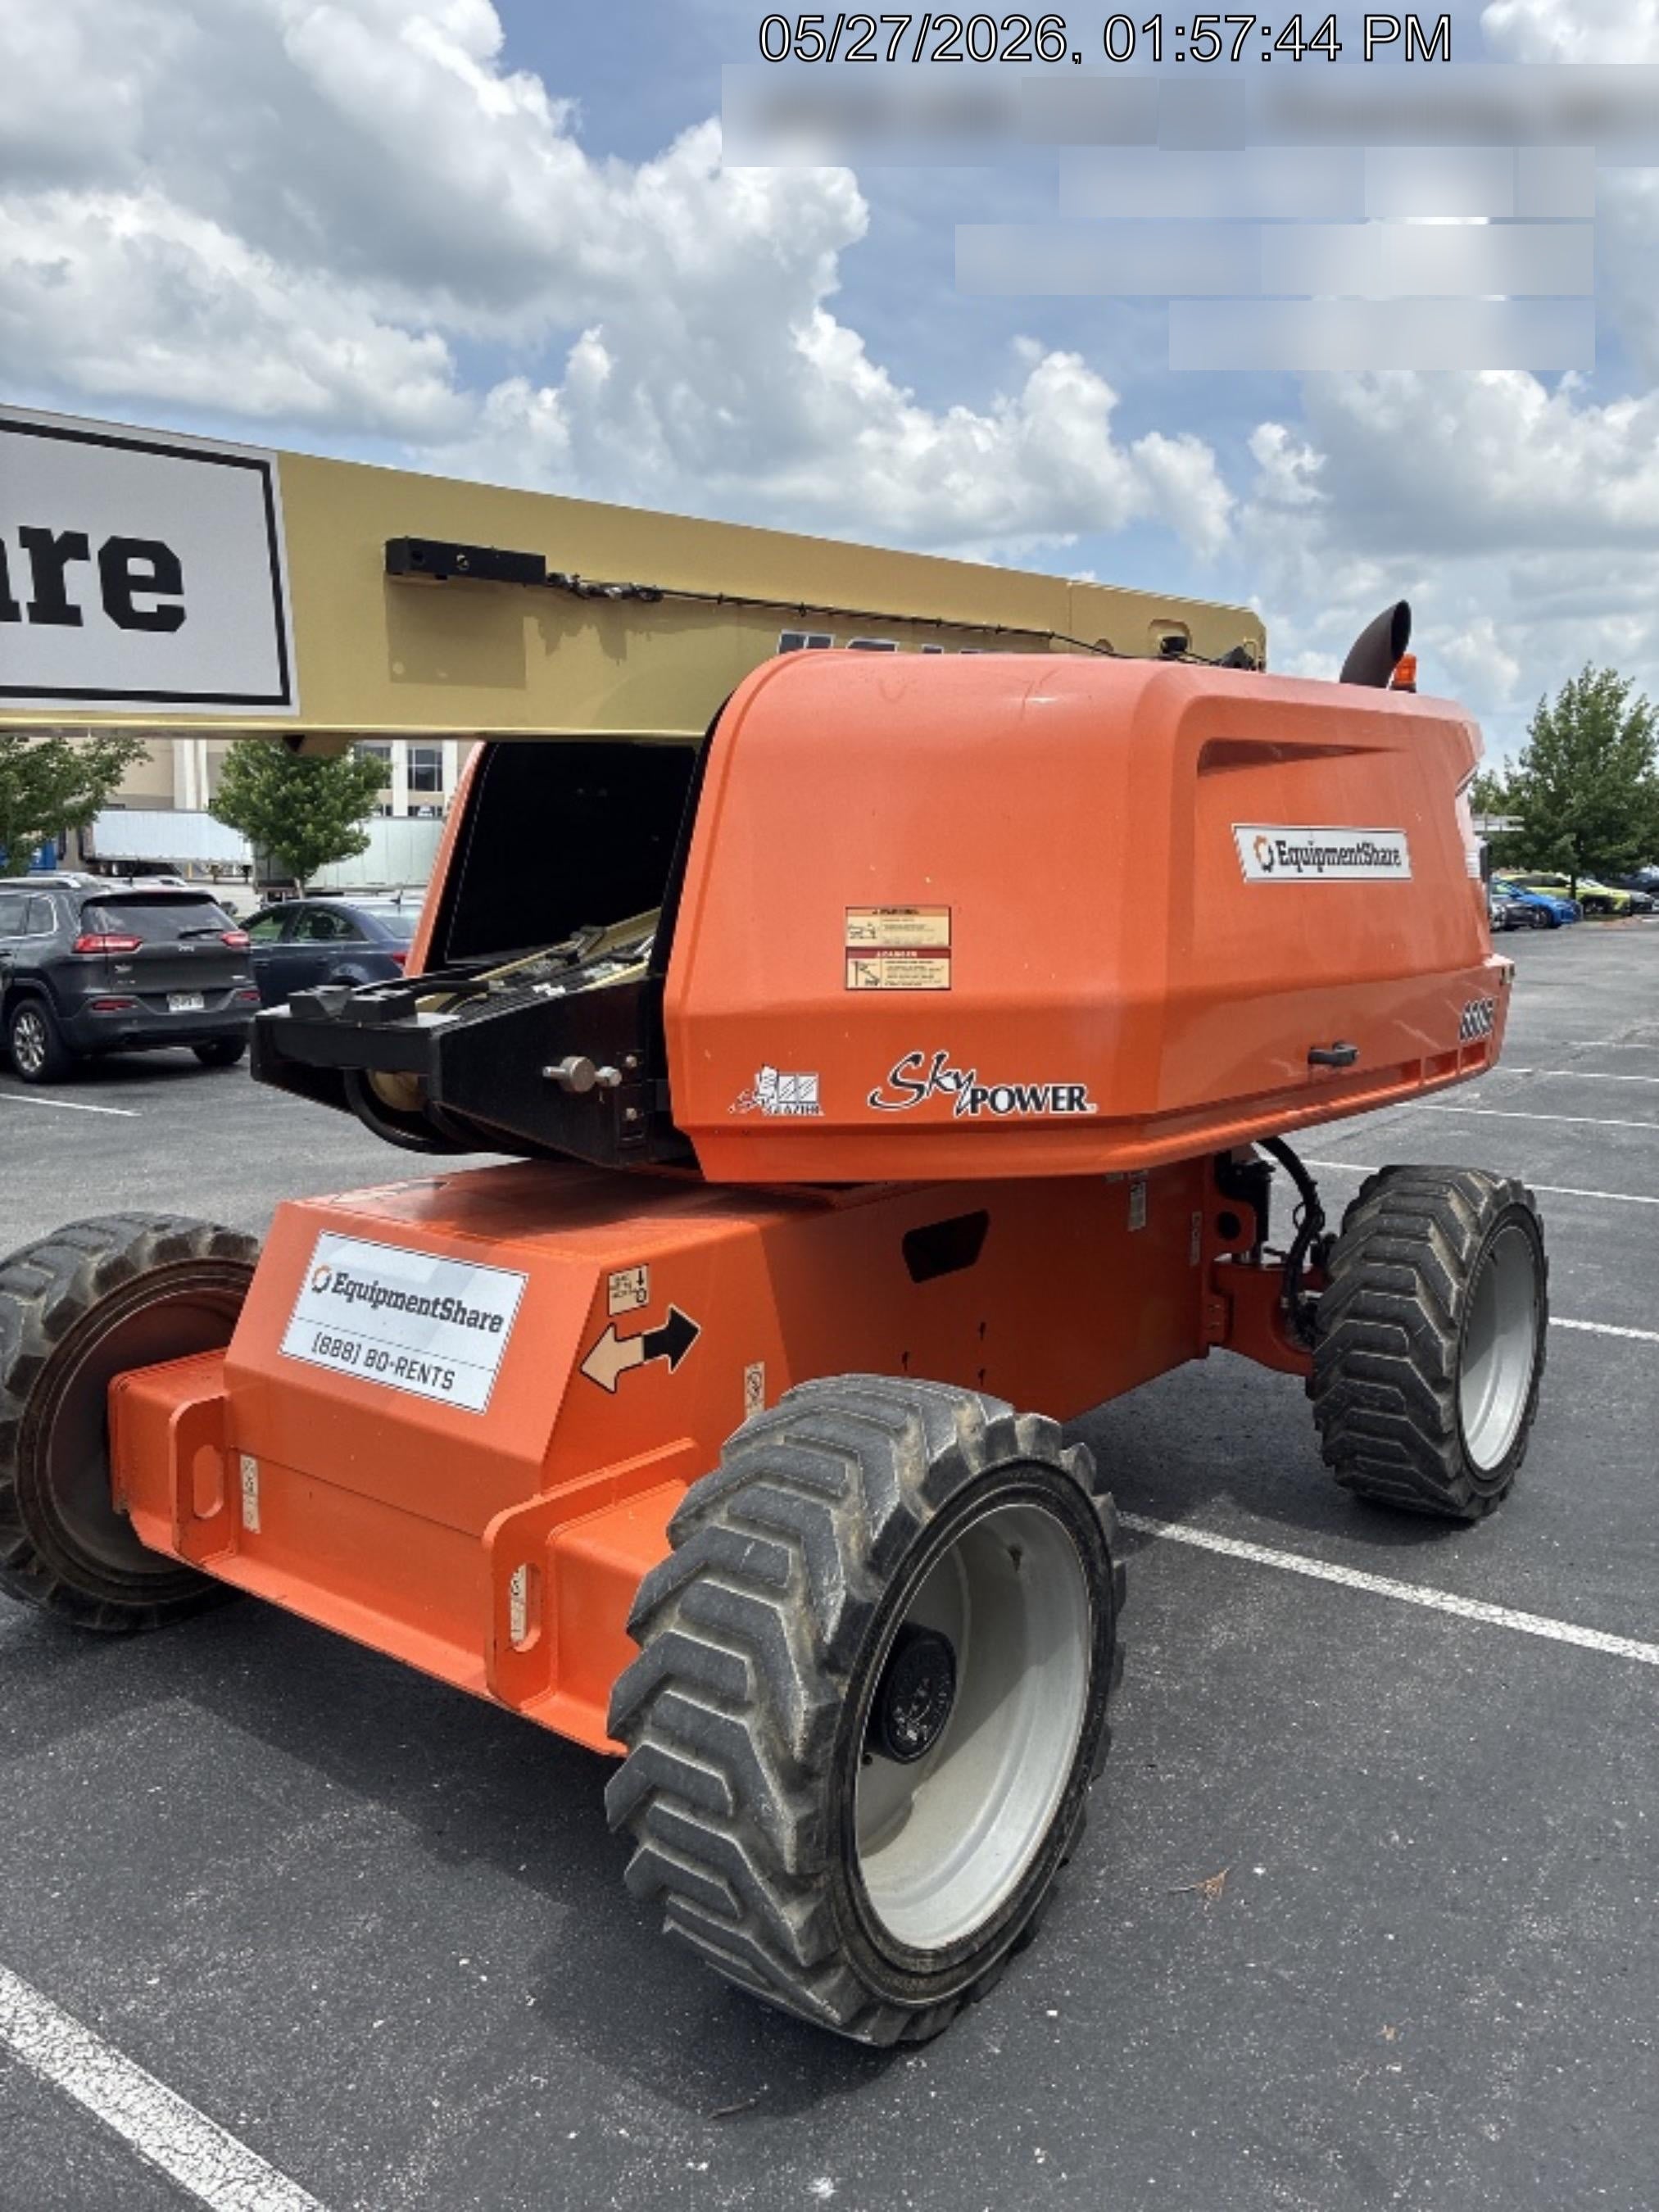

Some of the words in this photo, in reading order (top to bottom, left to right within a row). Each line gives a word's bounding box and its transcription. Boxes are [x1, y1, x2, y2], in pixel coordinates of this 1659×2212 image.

[0, 525, 187, 633] re
[1275, 840, 1402, 873] EquipmentShare
[868, 1050, 977, 1117] Sky
[968, 1083, 1088, 1115] POWER
[331, 1271, 504, 1334] EquipmentShare
